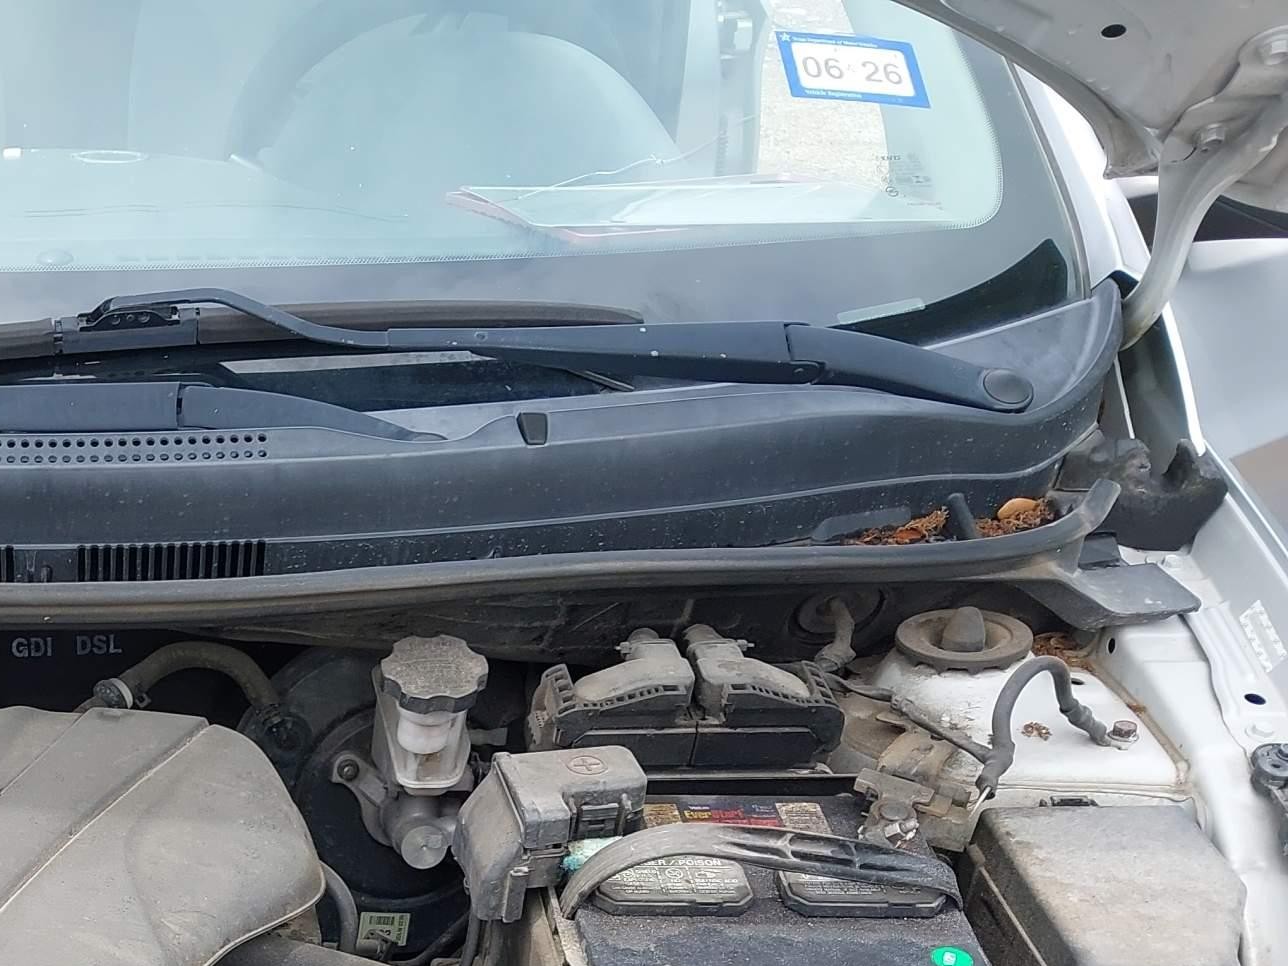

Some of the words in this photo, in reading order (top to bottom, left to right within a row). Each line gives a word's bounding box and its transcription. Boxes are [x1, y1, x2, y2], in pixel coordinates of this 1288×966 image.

[802, 56, 844, 79] 06
[861, 61, 903, 85] 26
[11, 637, 53, 658] GDI
[75, 634, 123, 655] DSL
[678, 859, 722, 867] POISON
